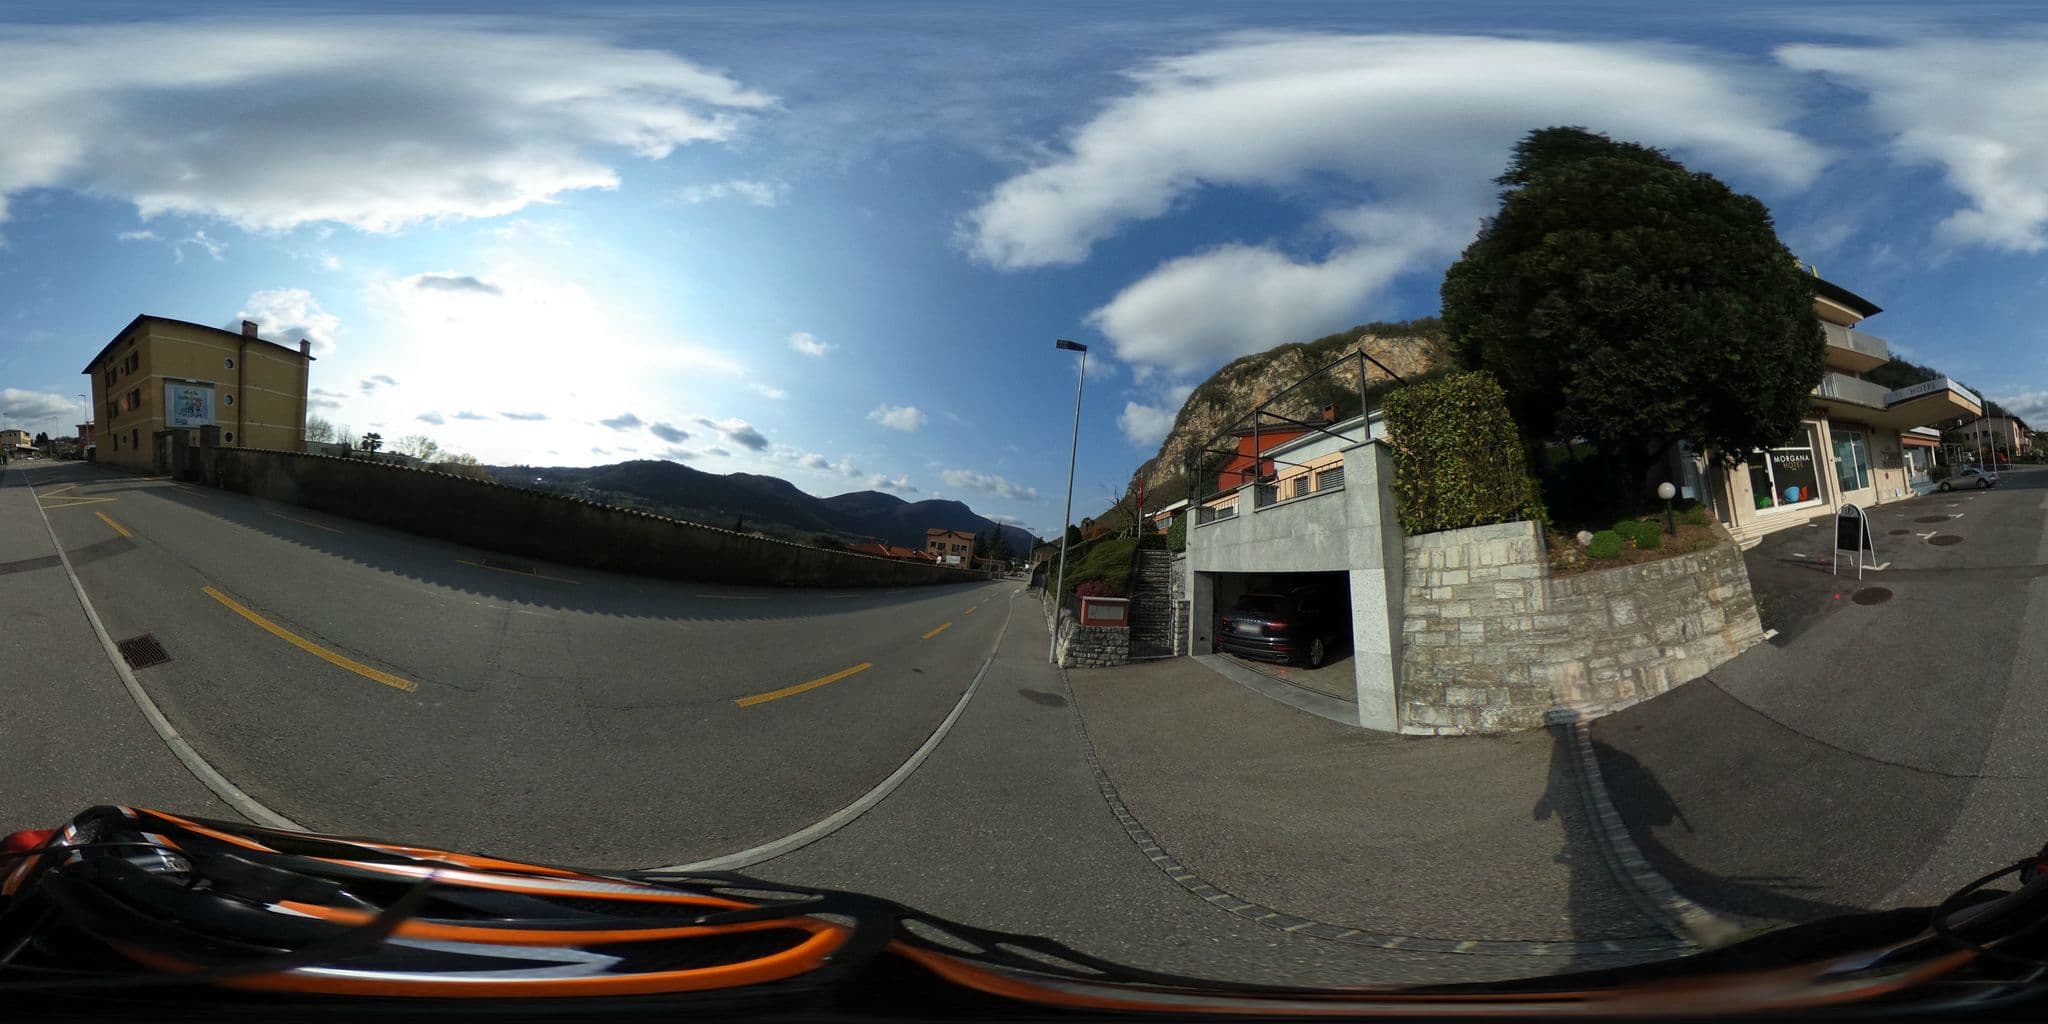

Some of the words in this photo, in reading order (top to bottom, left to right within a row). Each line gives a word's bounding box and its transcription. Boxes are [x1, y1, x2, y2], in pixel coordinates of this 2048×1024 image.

[1910, 383, 1937, 395] HOTEL
[1773, 454, 1810, 463] MORGANA
[1783, 461, 1804, 469] HOTEL
